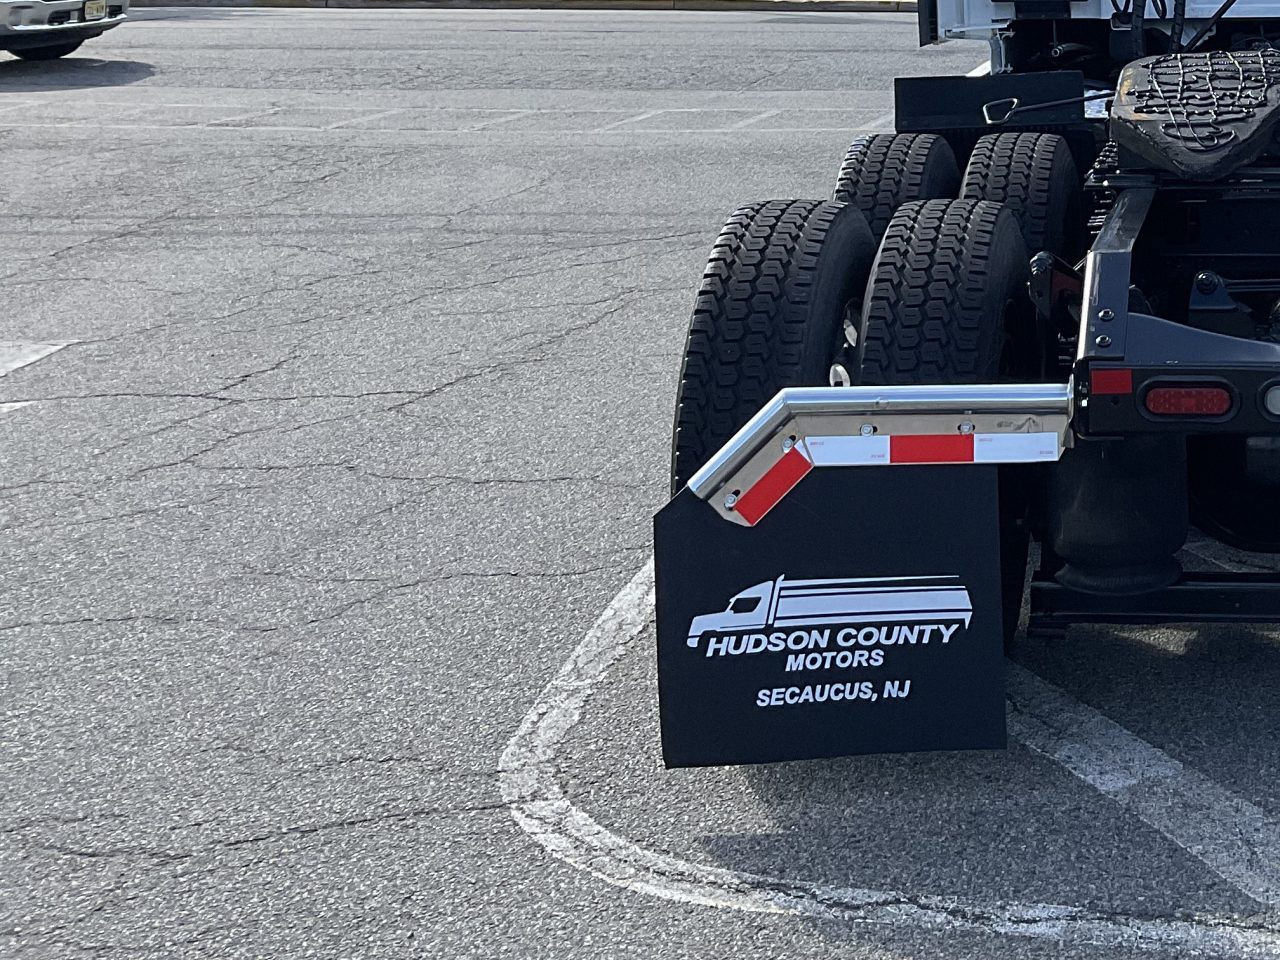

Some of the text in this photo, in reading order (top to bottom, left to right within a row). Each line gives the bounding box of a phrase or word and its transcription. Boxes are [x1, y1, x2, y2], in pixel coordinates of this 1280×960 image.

[706, 624, 960, 657] HUDSON COUNTY
[785, 650, 885, 672] MOTORS
[756, 680, 911, 707] SECAUCUS, NJ
